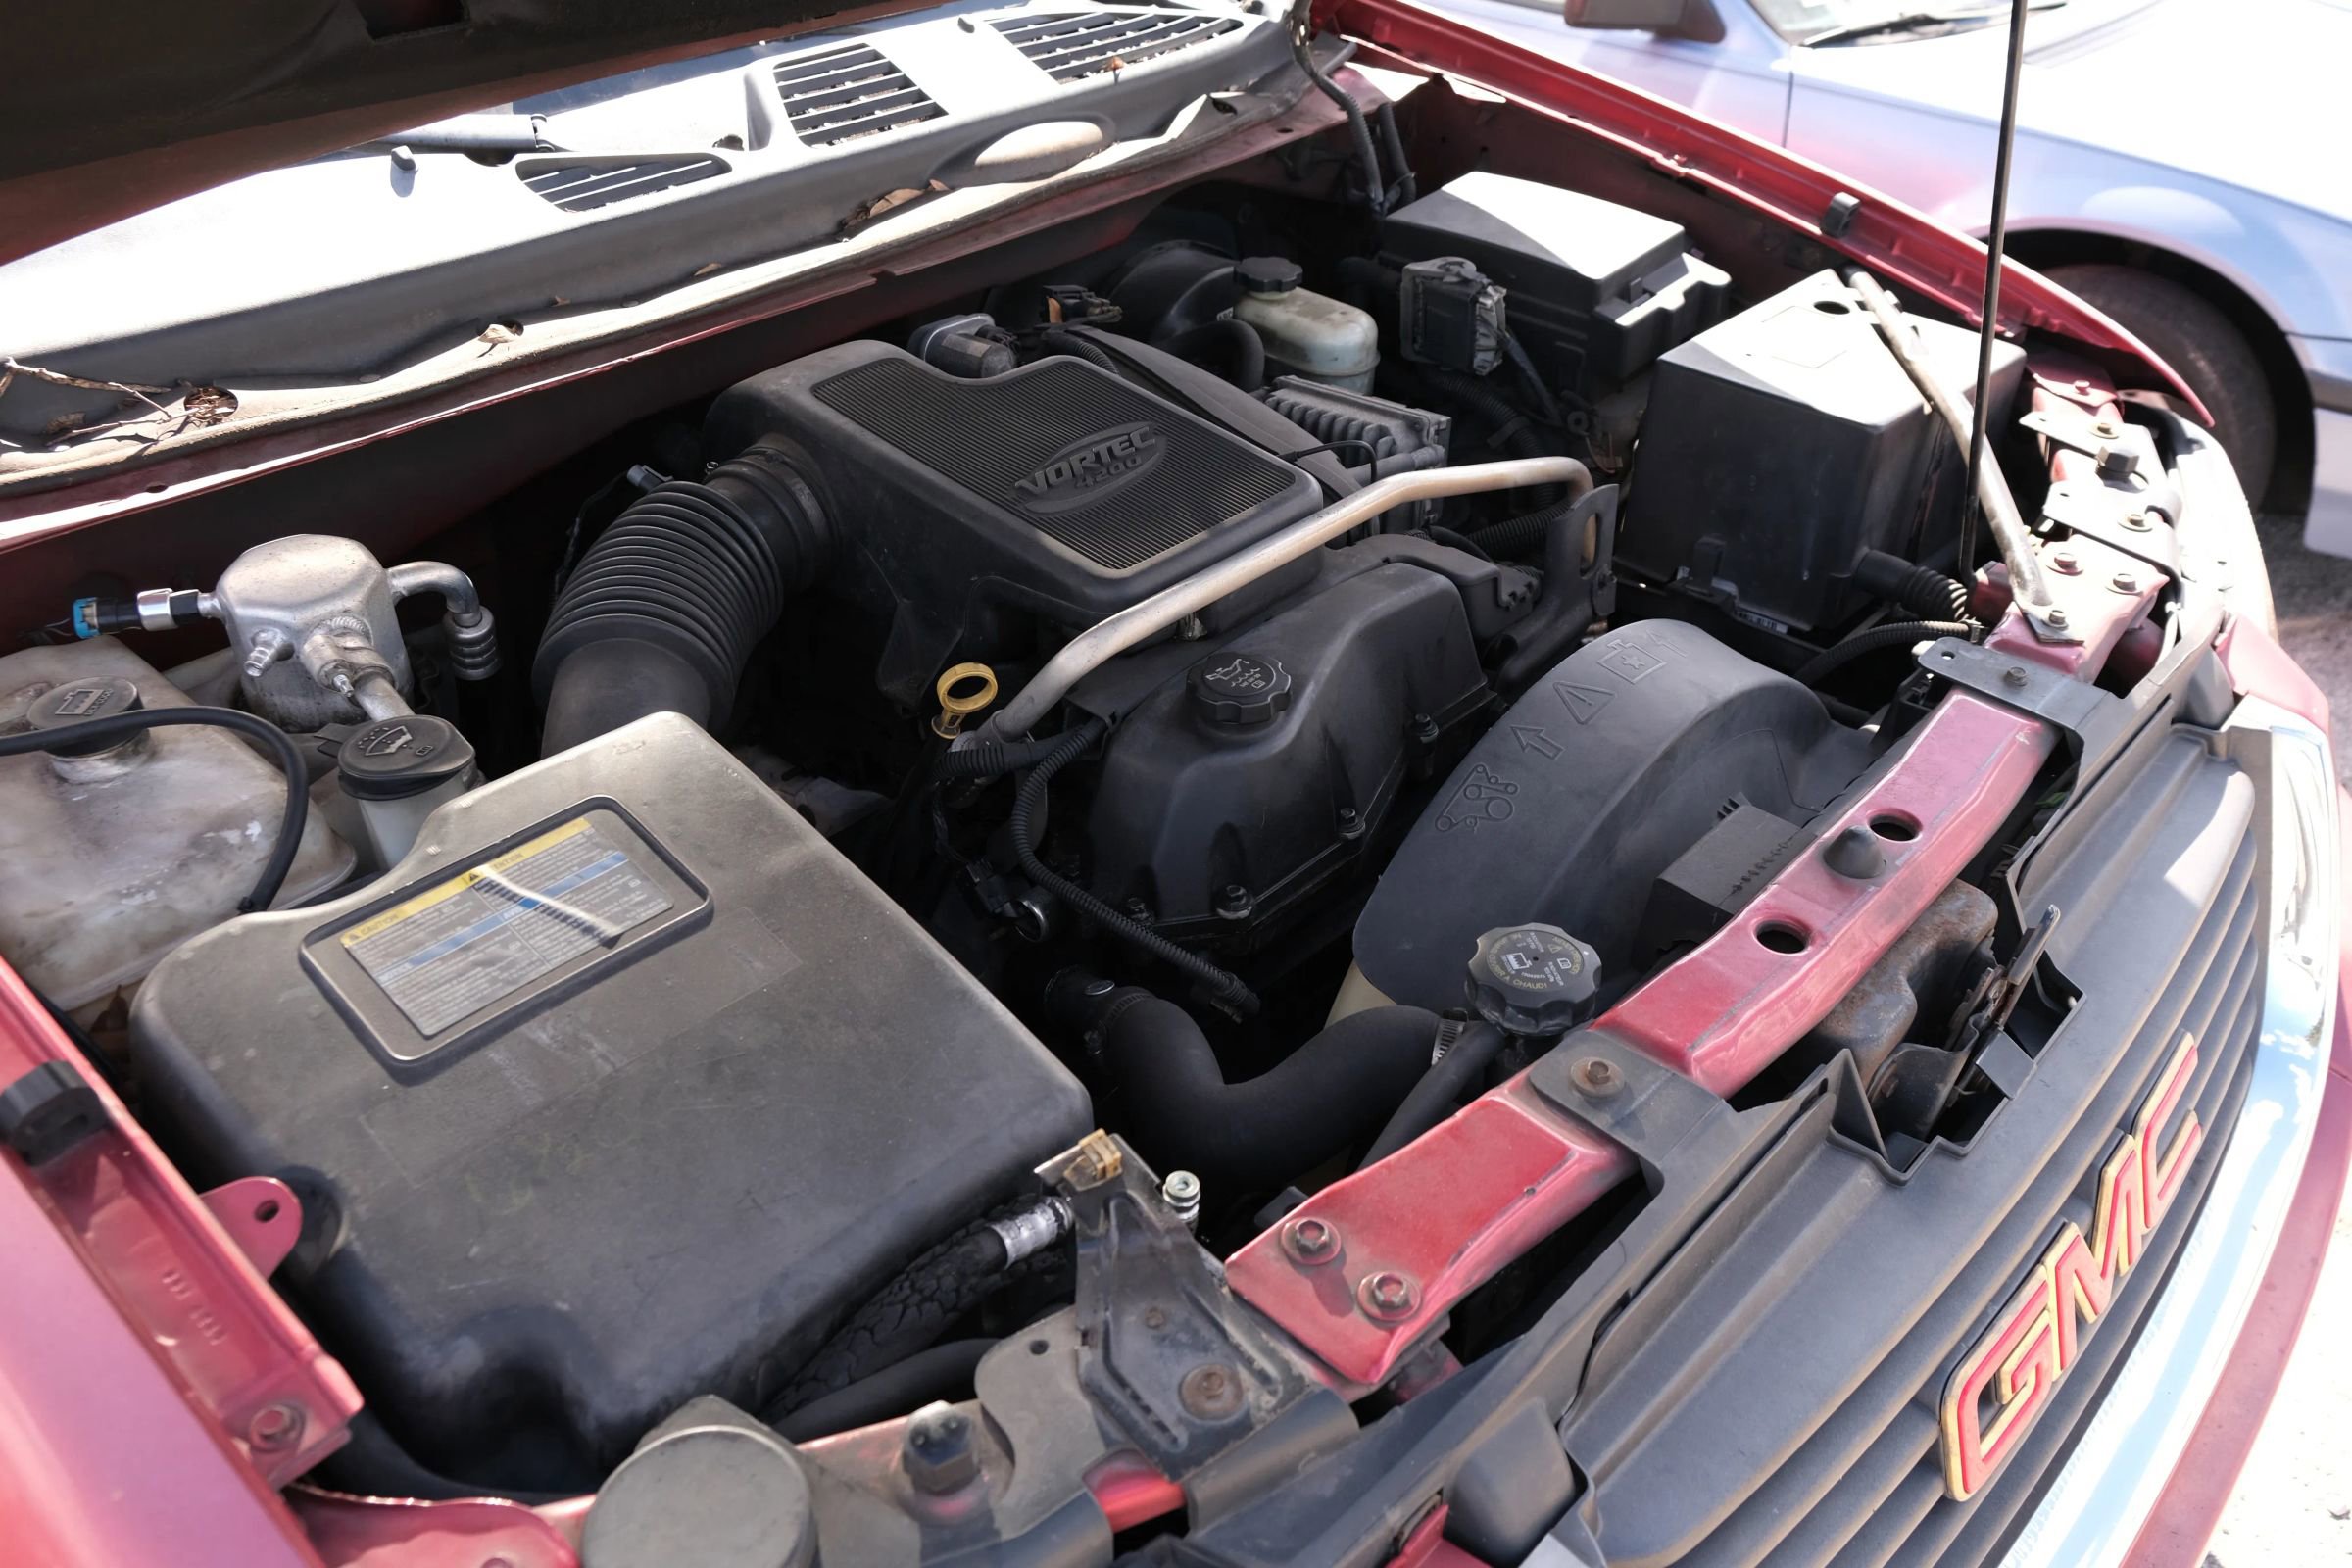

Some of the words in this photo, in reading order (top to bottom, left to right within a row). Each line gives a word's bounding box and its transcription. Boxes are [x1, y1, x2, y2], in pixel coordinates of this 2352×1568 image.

[1014, 426, 1155, 494] VORTEC
[1078, 457, 1143, 487] 4200
[360, 911, 400, 937] CAUTION
[1940, 1028, 2202, 1502] GMC
